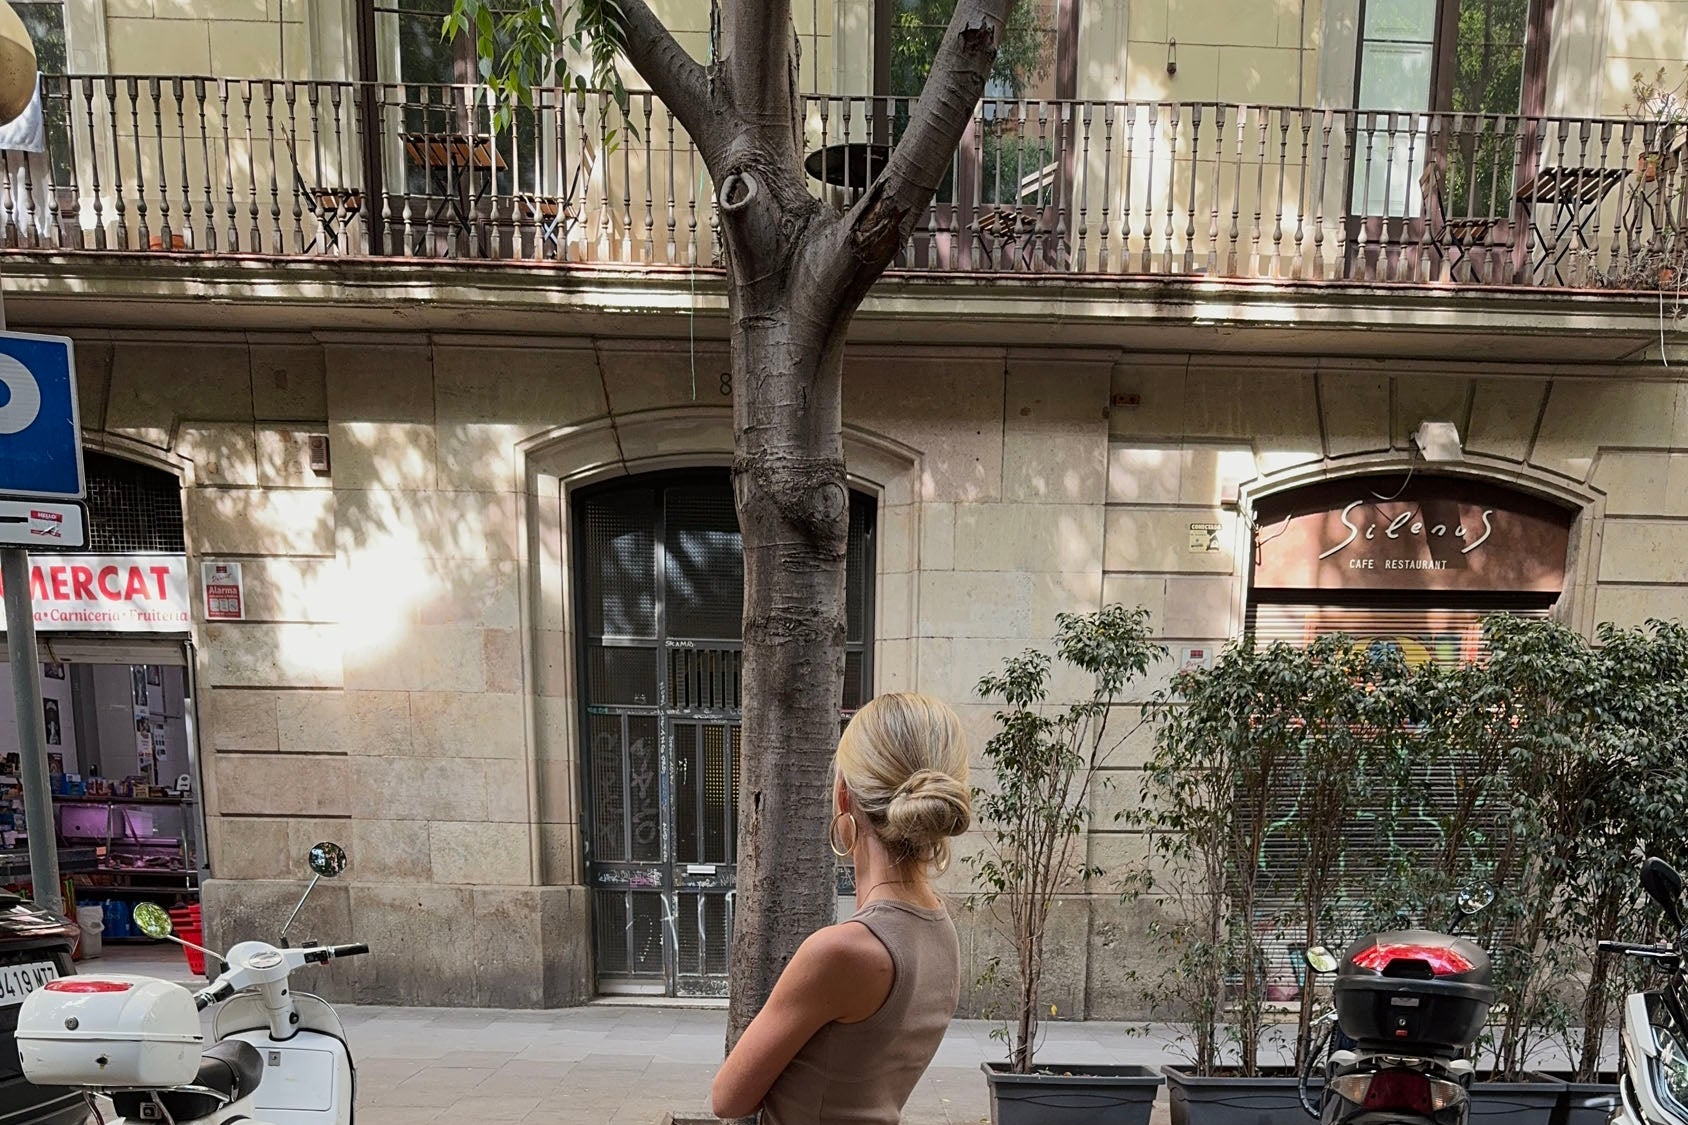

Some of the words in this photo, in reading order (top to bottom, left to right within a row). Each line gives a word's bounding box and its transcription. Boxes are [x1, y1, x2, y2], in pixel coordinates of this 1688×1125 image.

[720, 373, 732, 396] 8
[1350, 559, 1374, 569] CAFE
[1385, 559, 1447, 570] RESTAURANT
[209, 586, 238, 595] Alarma
